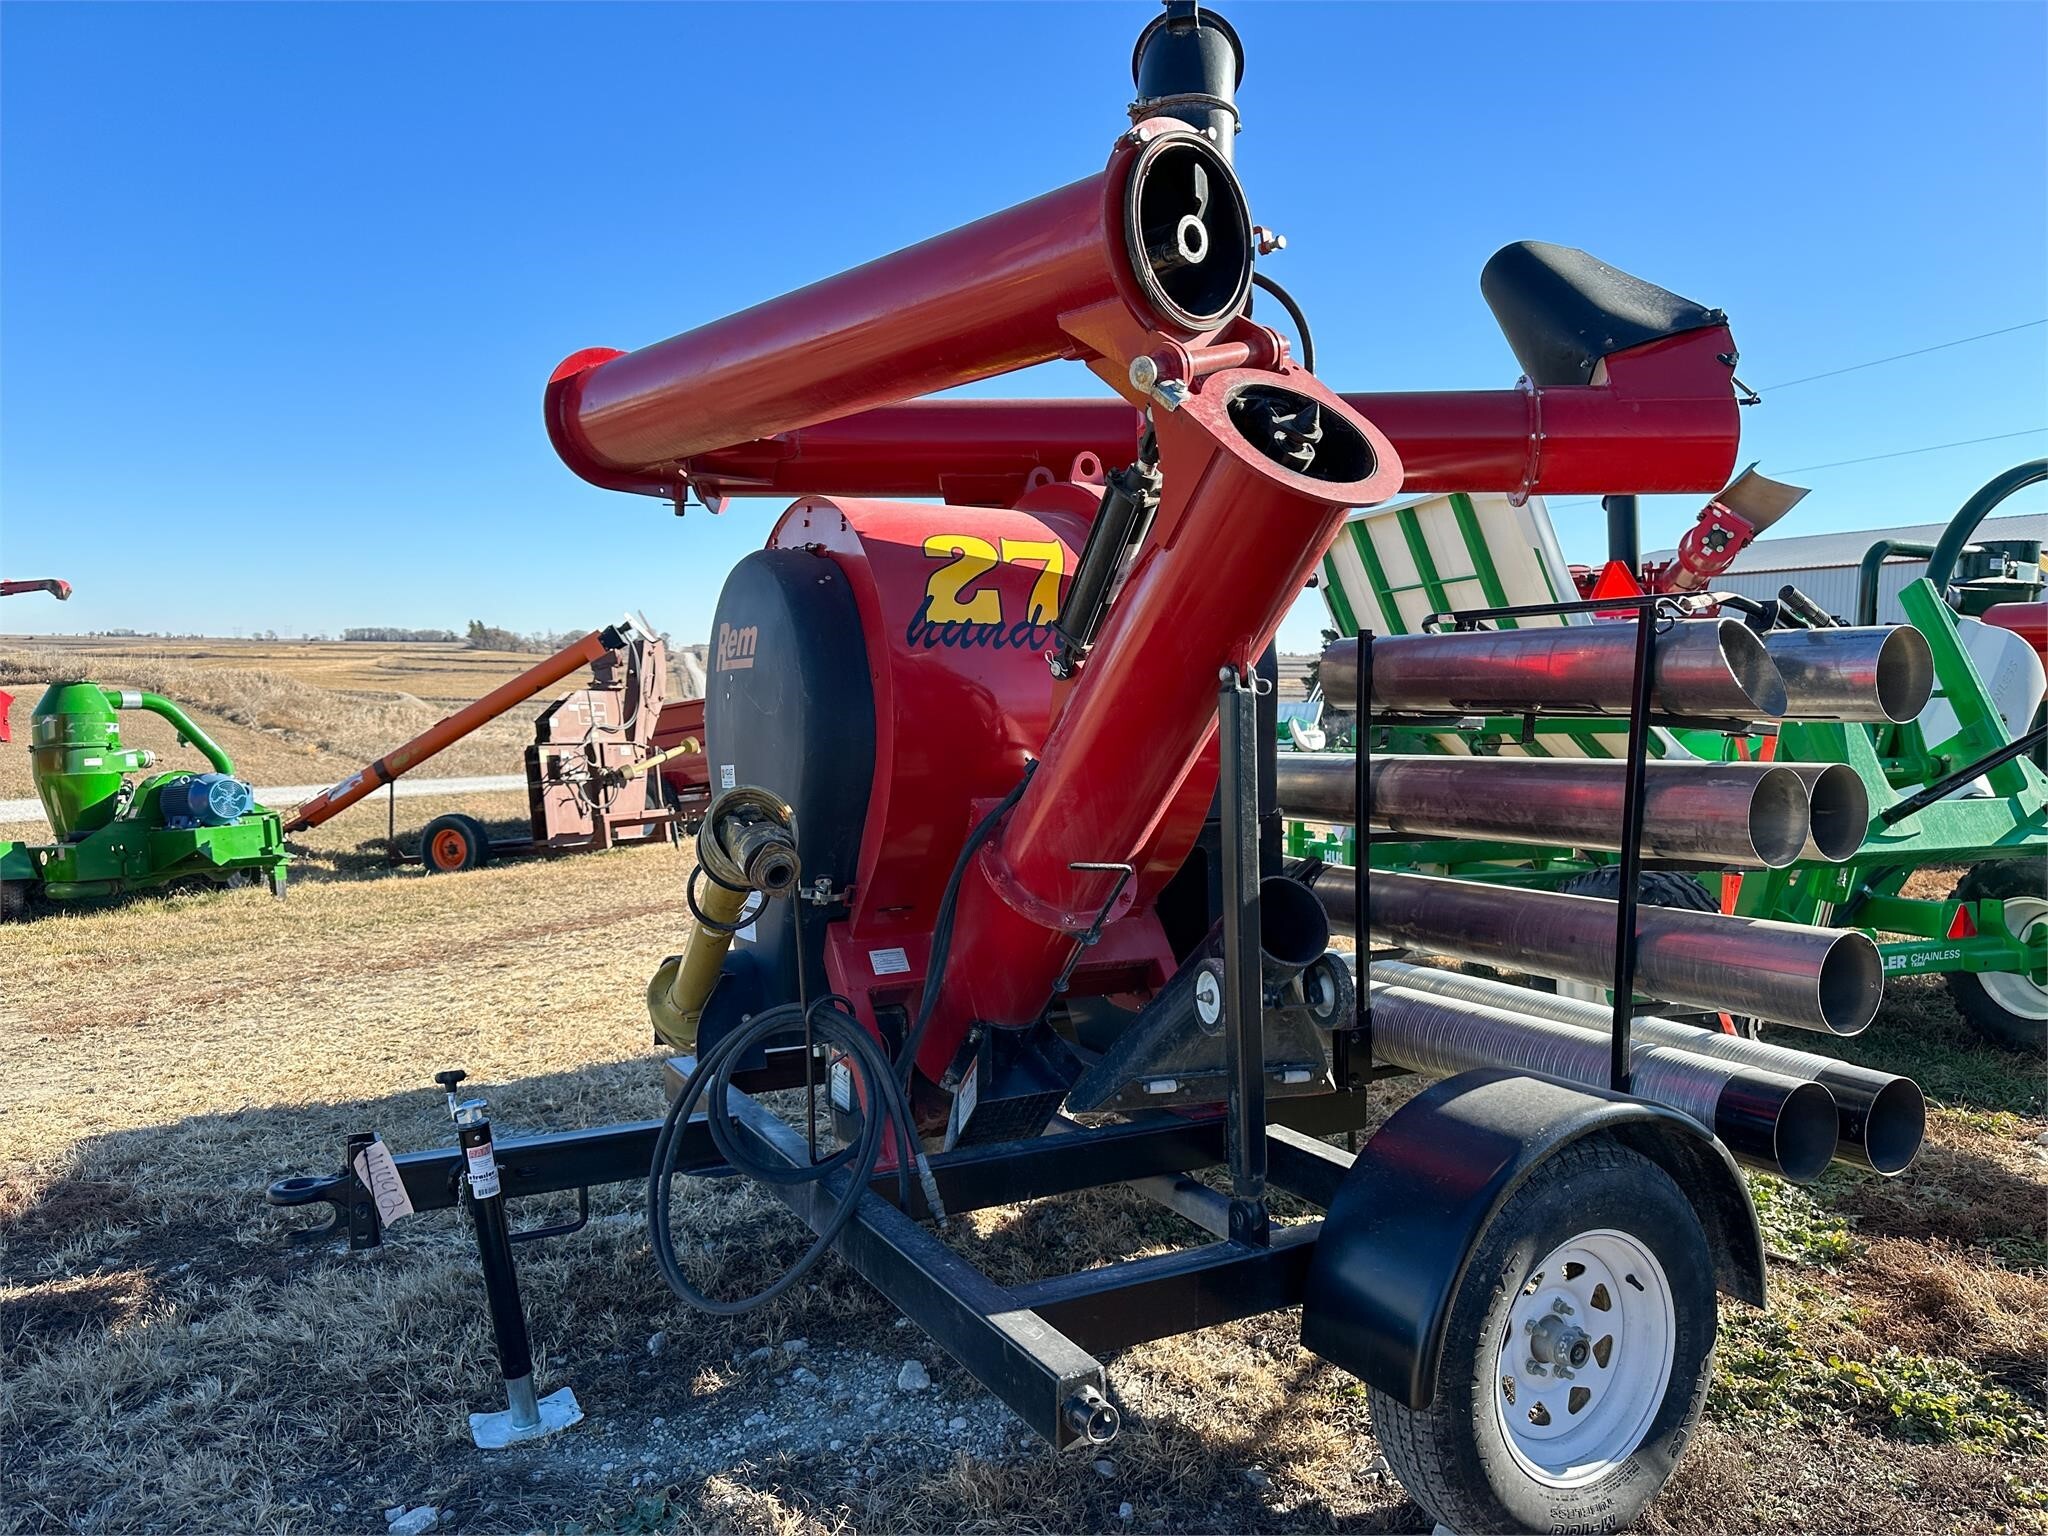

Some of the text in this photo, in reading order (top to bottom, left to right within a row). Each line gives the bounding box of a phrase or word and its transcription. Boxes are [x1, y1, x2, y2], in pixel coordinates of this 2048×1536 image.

[922, 533, 1065, 626] 27
[716, 622, 758, 672] Rem
[1910, 949, 1961, 963] CHAINLESS
